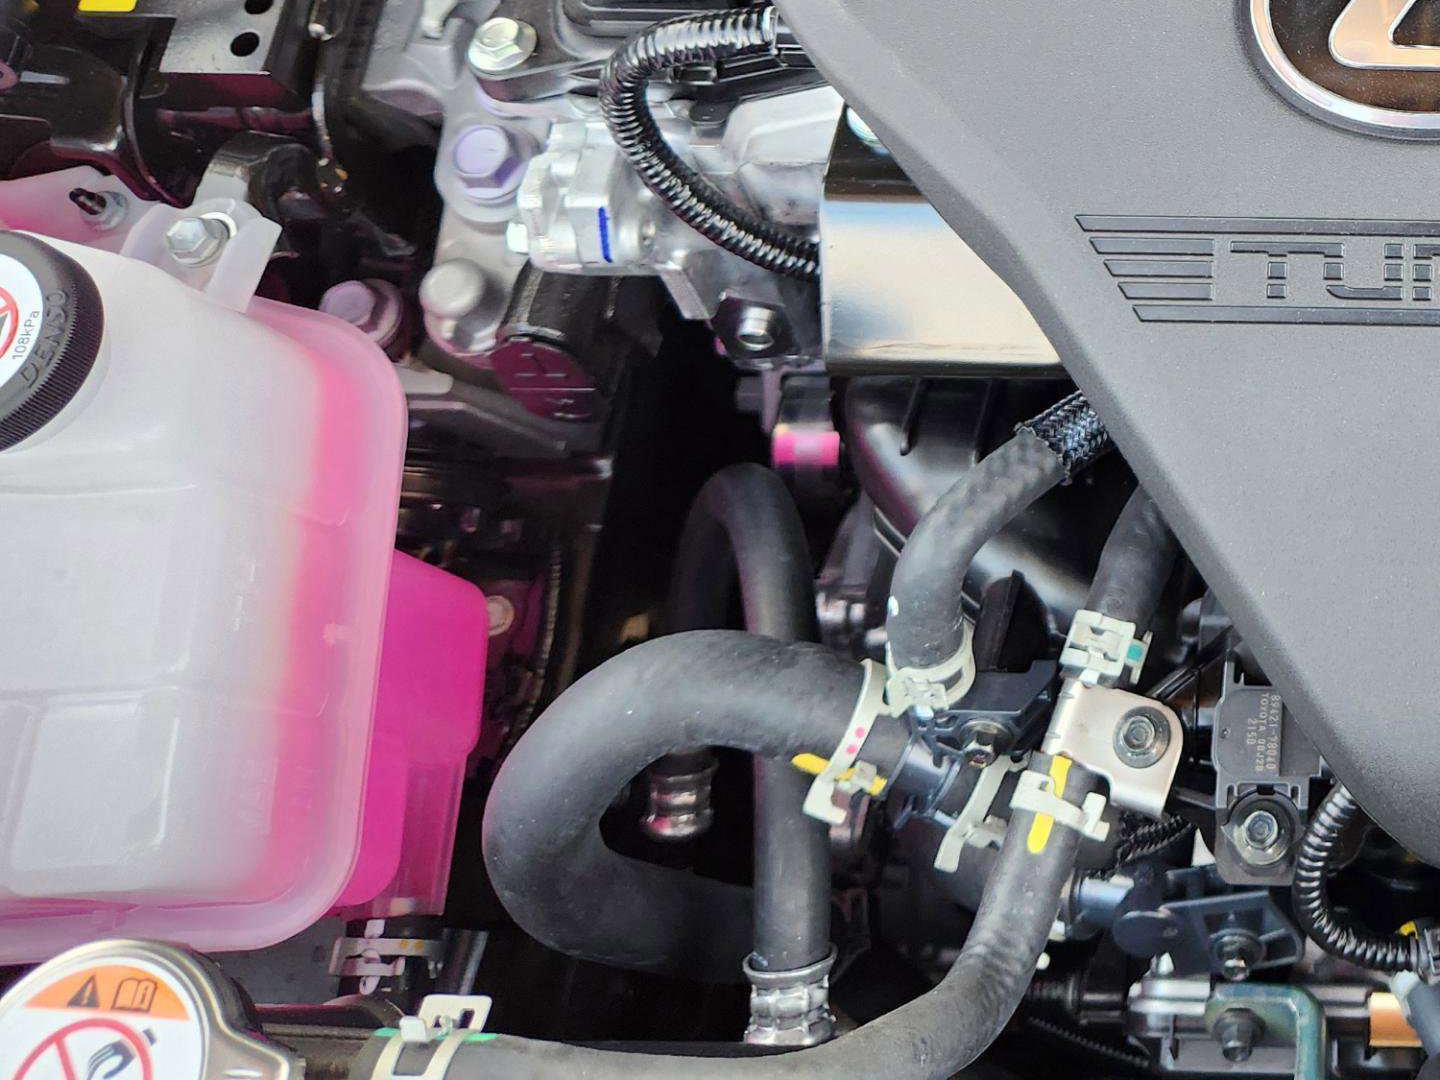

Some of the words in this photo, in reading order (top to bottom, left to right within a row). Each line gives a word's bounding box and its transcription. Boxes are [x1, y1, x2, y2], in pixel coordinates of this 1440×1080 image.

[11, 310, 40, 360] 108kPa
[20, 287, 69, 389] DENSO
[1258, 692, 1269, 731] TOYOTA
